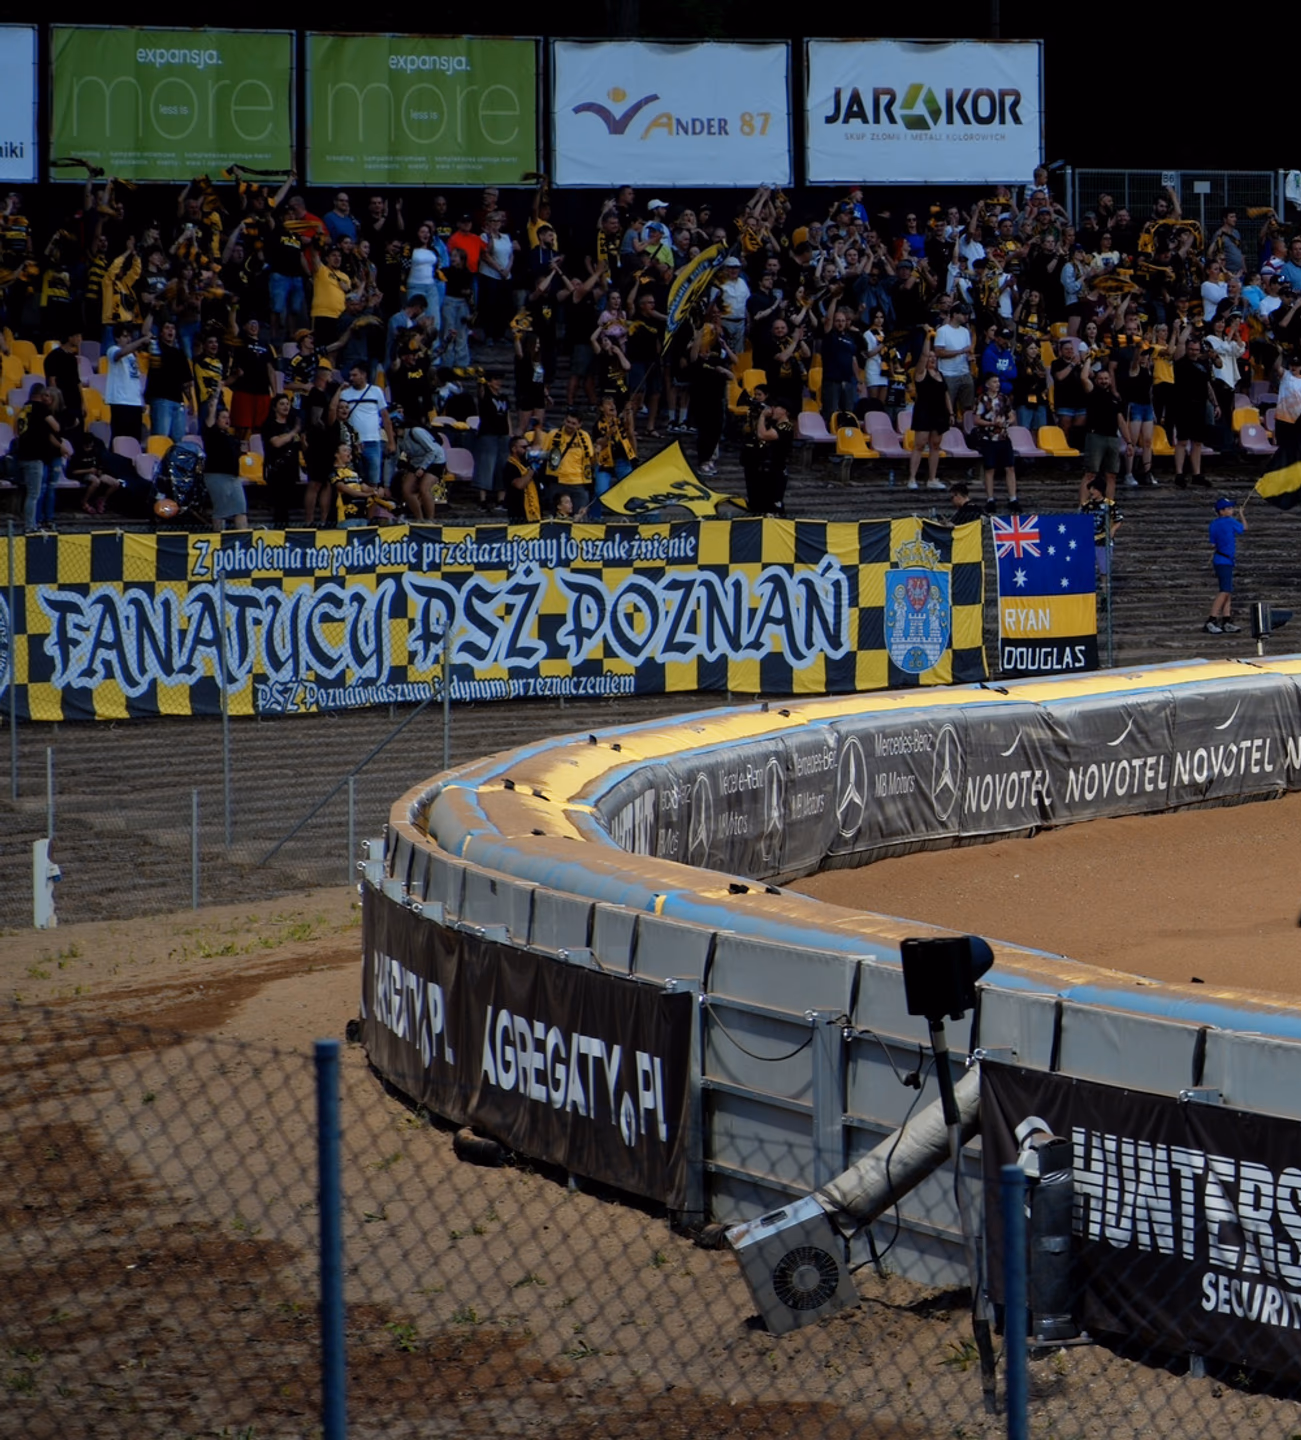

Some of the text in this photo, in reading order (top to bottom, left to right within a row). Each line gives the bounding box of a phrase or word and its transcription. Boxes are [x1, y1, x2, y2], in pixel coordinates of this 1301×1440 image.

[136, 47, 222, 69] expansja.
[388, 54, 471, 75] expansja.
[72, 75, 274, 141] more
[327, 82, 521, 145] more
[739, 111, 772, 137] 87
[191, 539, 211, 577] Z
[212, 538, 301, 579] pokolenia
[305, 548, 330, 569] na
[330, 535, 419, 575] pokolenie
[559, 532, 578, 562] to
[402, 560, 548, 671] PSŻ
[555, 554, 851, 669] POZNAŃ
[1004, 608, 1051, 632] RYAN
[1002, 645, 1086, 670] DOUGLAS
[253, 675, 300, 711] PSŻ
[300, 679, 366, 710] Poznań
[507, 672, 636, 699] przeznaczeniem
[1065, 755, 1168, 803] NOVOTEL
[1172, 737, 1275, 786] NOVOTEL
[964, 769, 1052, 814] NOVOTEL
[481, 1004, 668, 1148] AGREGATY.PL
